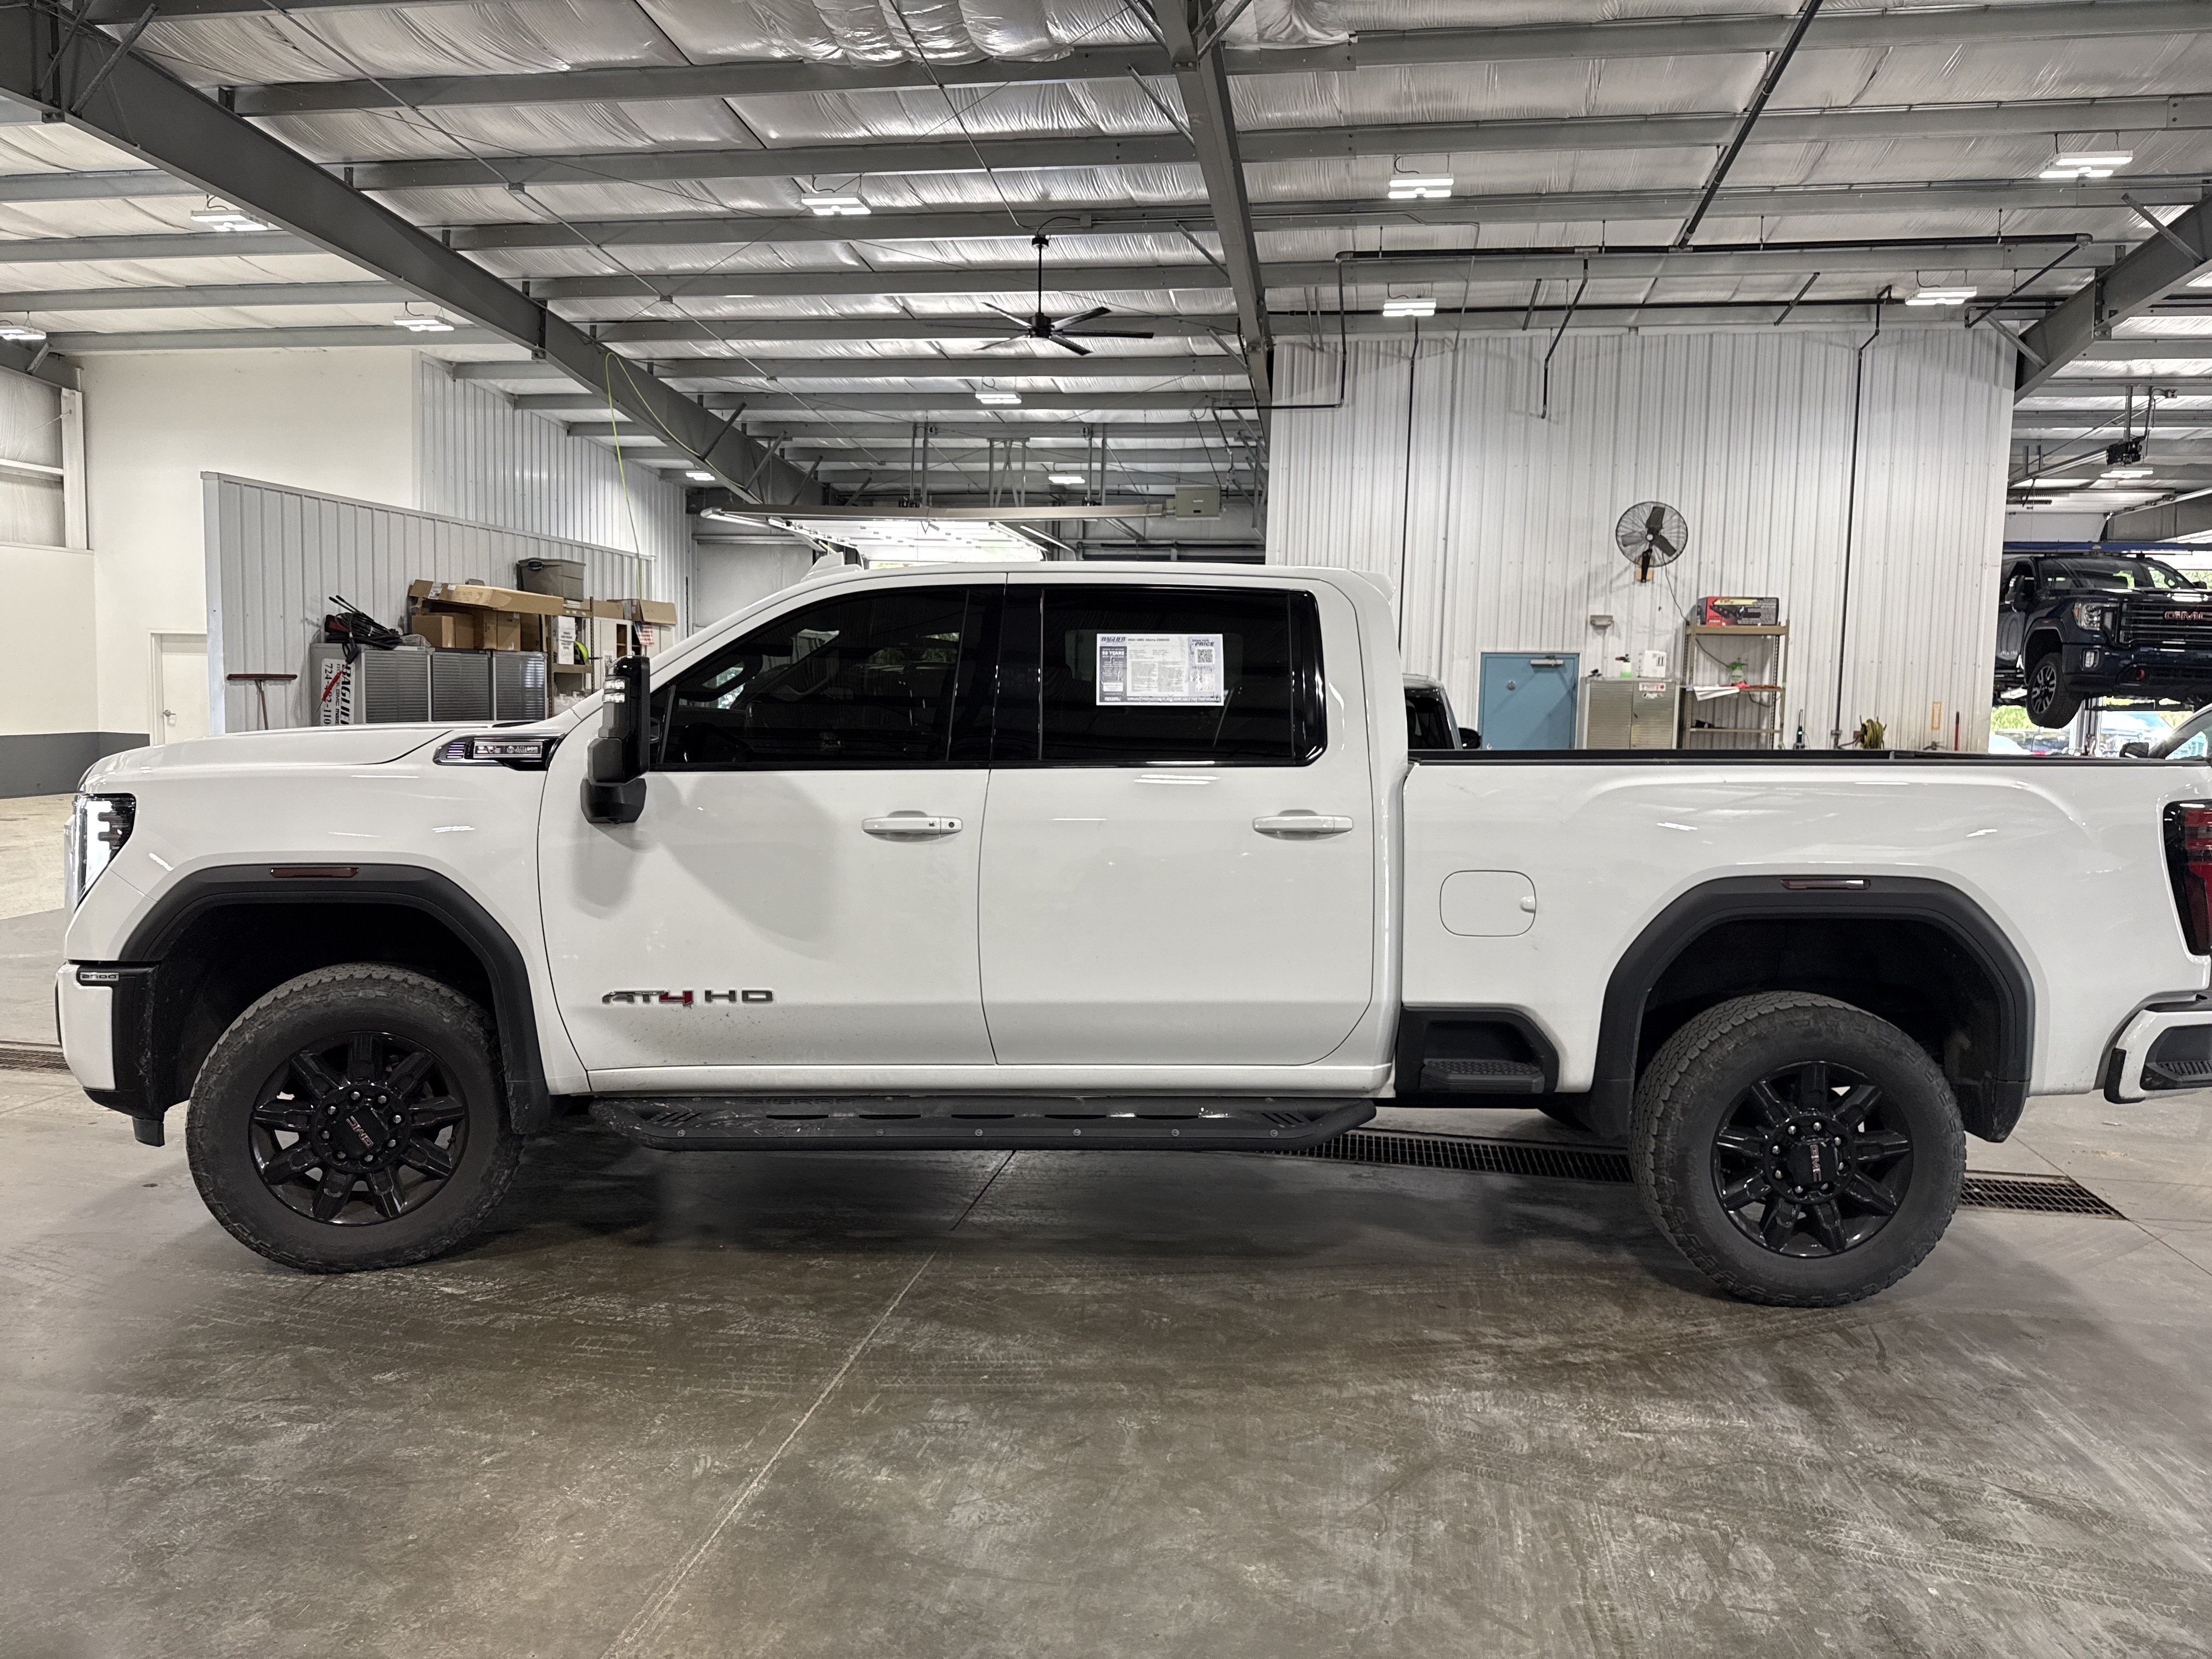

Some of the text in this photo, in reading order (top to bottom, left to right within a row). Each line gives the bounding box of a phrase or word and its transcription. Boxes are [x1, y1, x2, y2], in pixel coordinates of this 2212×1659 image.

[2164, 611, 2212, 621] GMC
[602, 989, 773, 1006] AT4 HD
[346, 1115, 374, 1148] GMC
[1810, 1144, 1822, 1183] GMC
